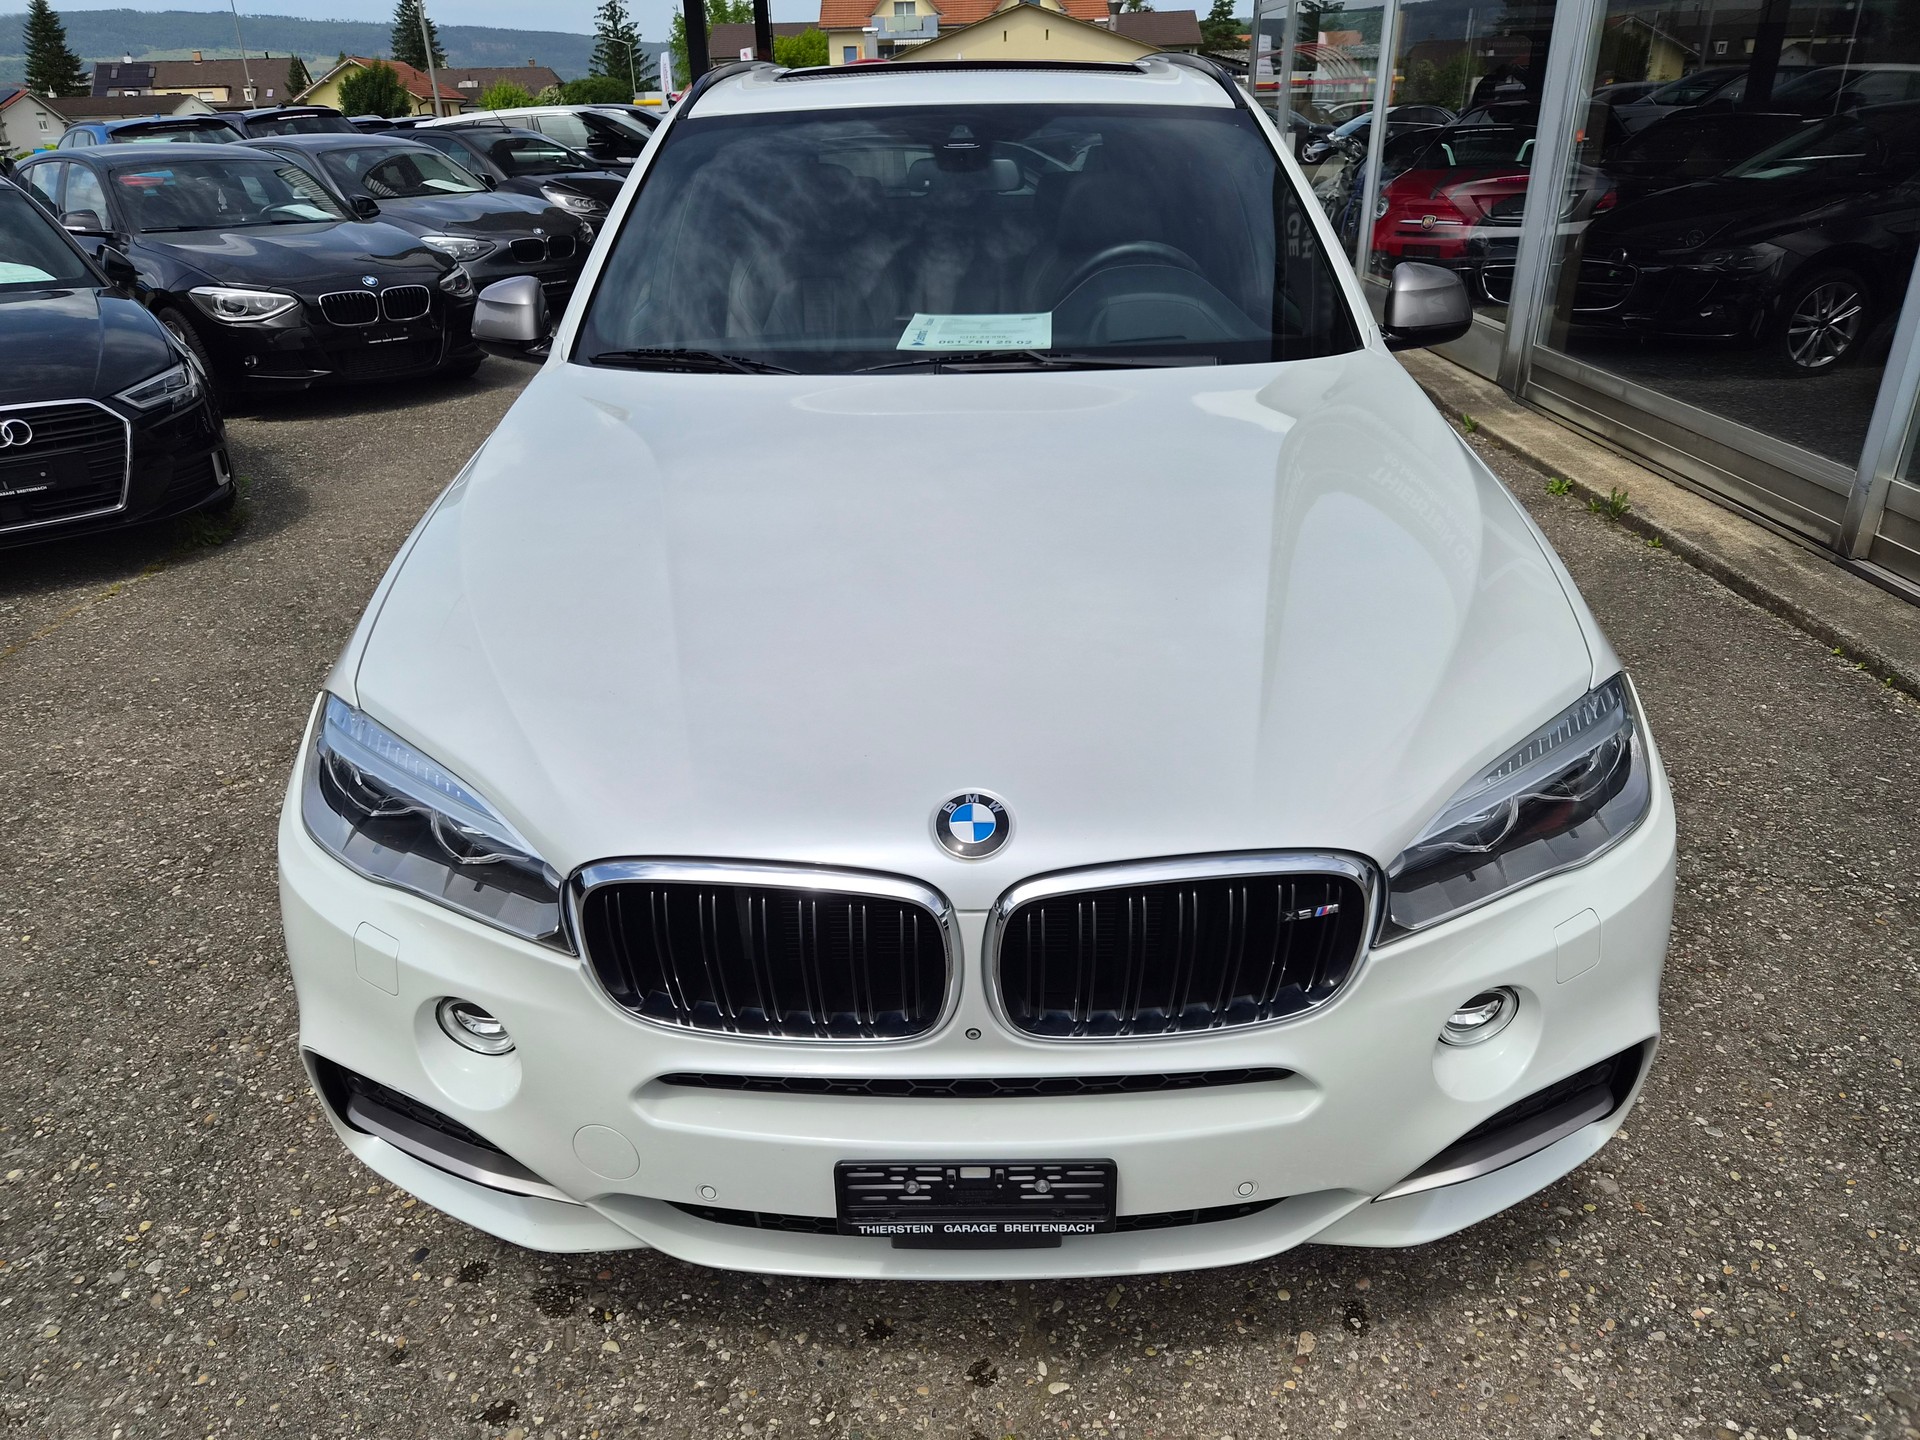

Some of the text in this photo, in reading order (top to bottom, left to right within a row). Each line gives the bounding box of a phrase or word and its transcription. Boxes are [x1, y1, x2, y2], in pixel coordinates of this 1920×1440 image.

[942, 793, 1004, 814] BMW
[1282, 909, 1312, 921] X5
[859, 1223, 1095, 1234] THIERSTEIN GARAGE BREITENBACH
